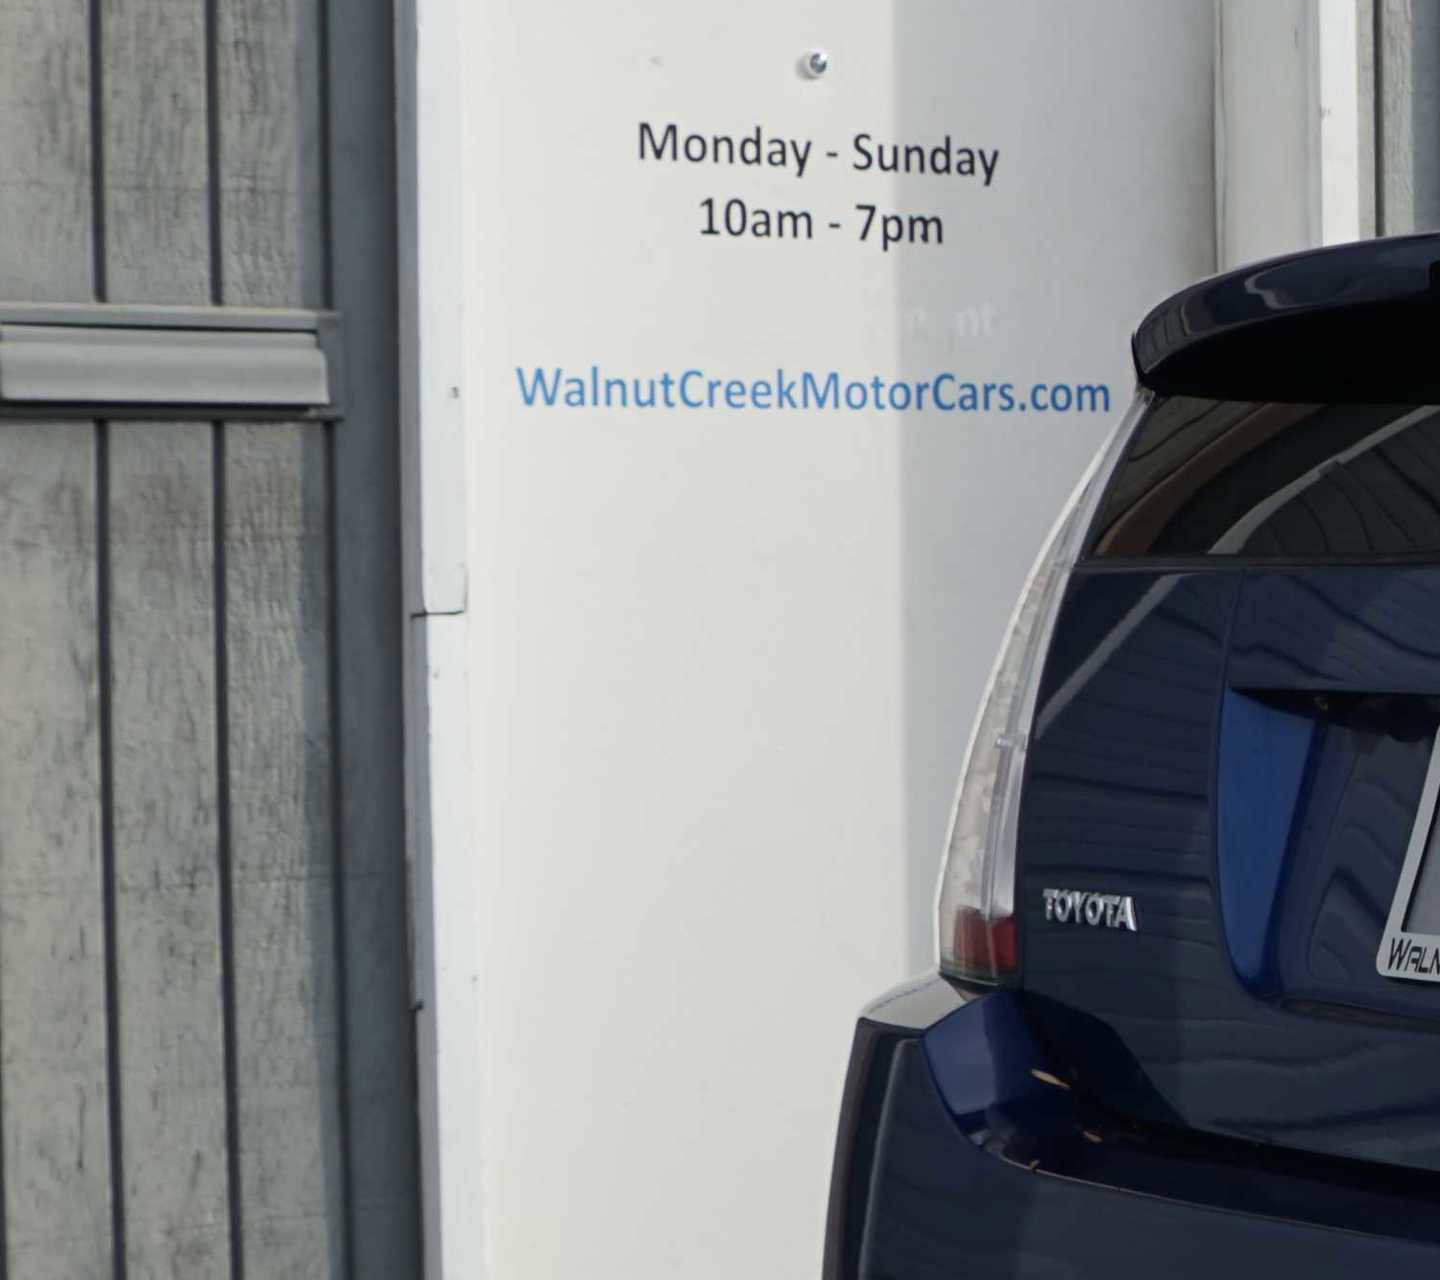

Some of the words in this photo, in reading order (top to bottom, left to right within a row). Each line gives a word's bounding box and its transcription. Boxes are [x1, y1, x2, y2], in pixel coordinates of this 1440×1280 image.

[638, 122, 812, 177] Monday
[852, 134, 1000, 186] Sunday
[699, 198, 813, 241] 10am
[855, 204, 945, 251] 7pm
[516, 367, 1112, 413] WalnutCreekMotorCars.com
[1042, 888, 1137, 931] TOYOTA
